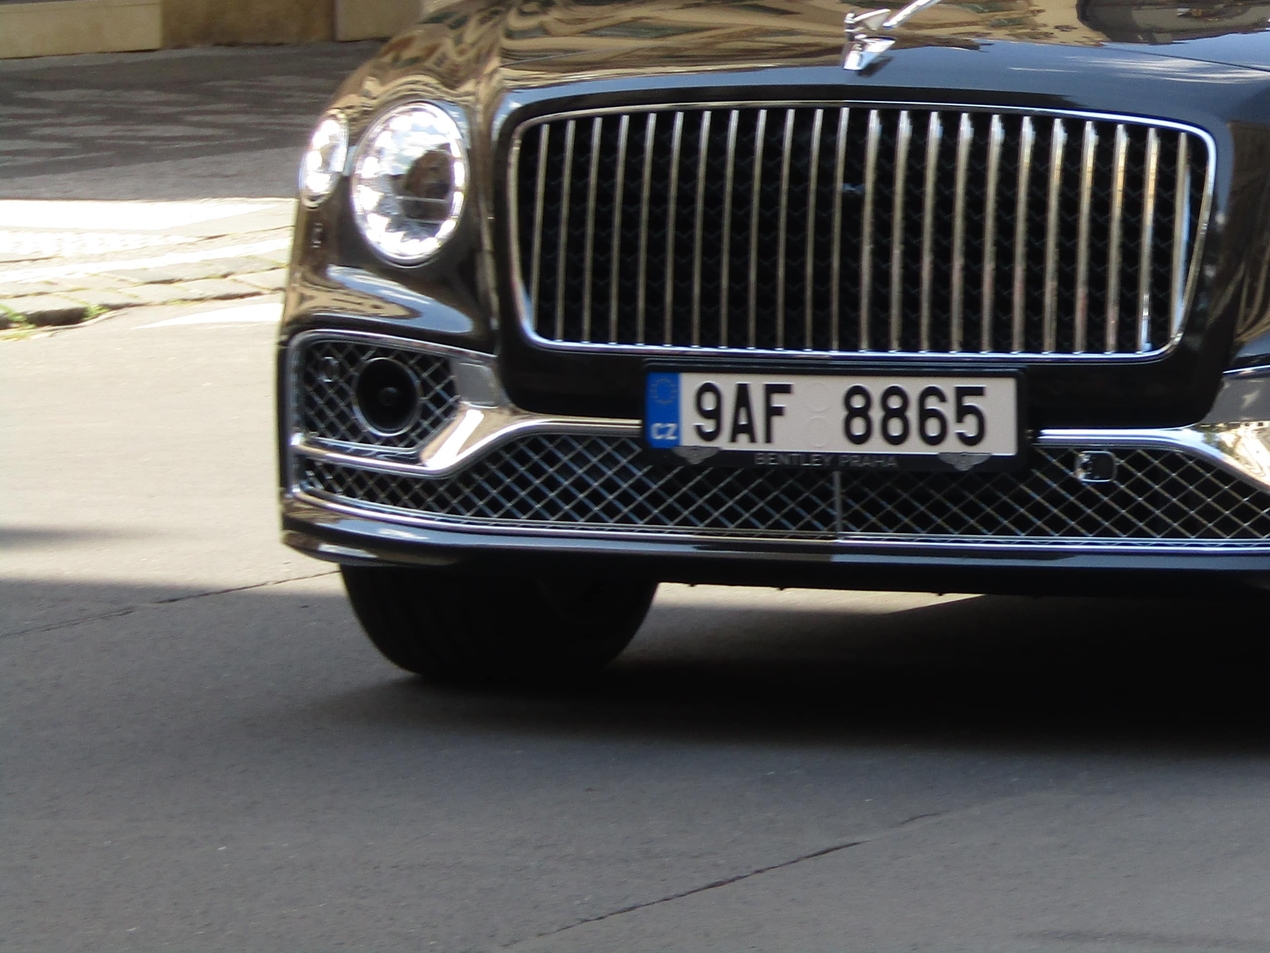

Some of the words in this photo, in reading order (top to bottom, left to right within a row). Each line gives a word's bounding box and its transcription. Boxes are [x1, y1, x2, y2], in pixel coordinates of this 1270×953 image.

[693, 381, 794, 444] 9AF
[843, 383, 986, 446] 8865
[650, 422, 678, 441] CZ
[754, 452, 834, 466] BENTLEY
[838, 453, 898, 468] PRAHA
